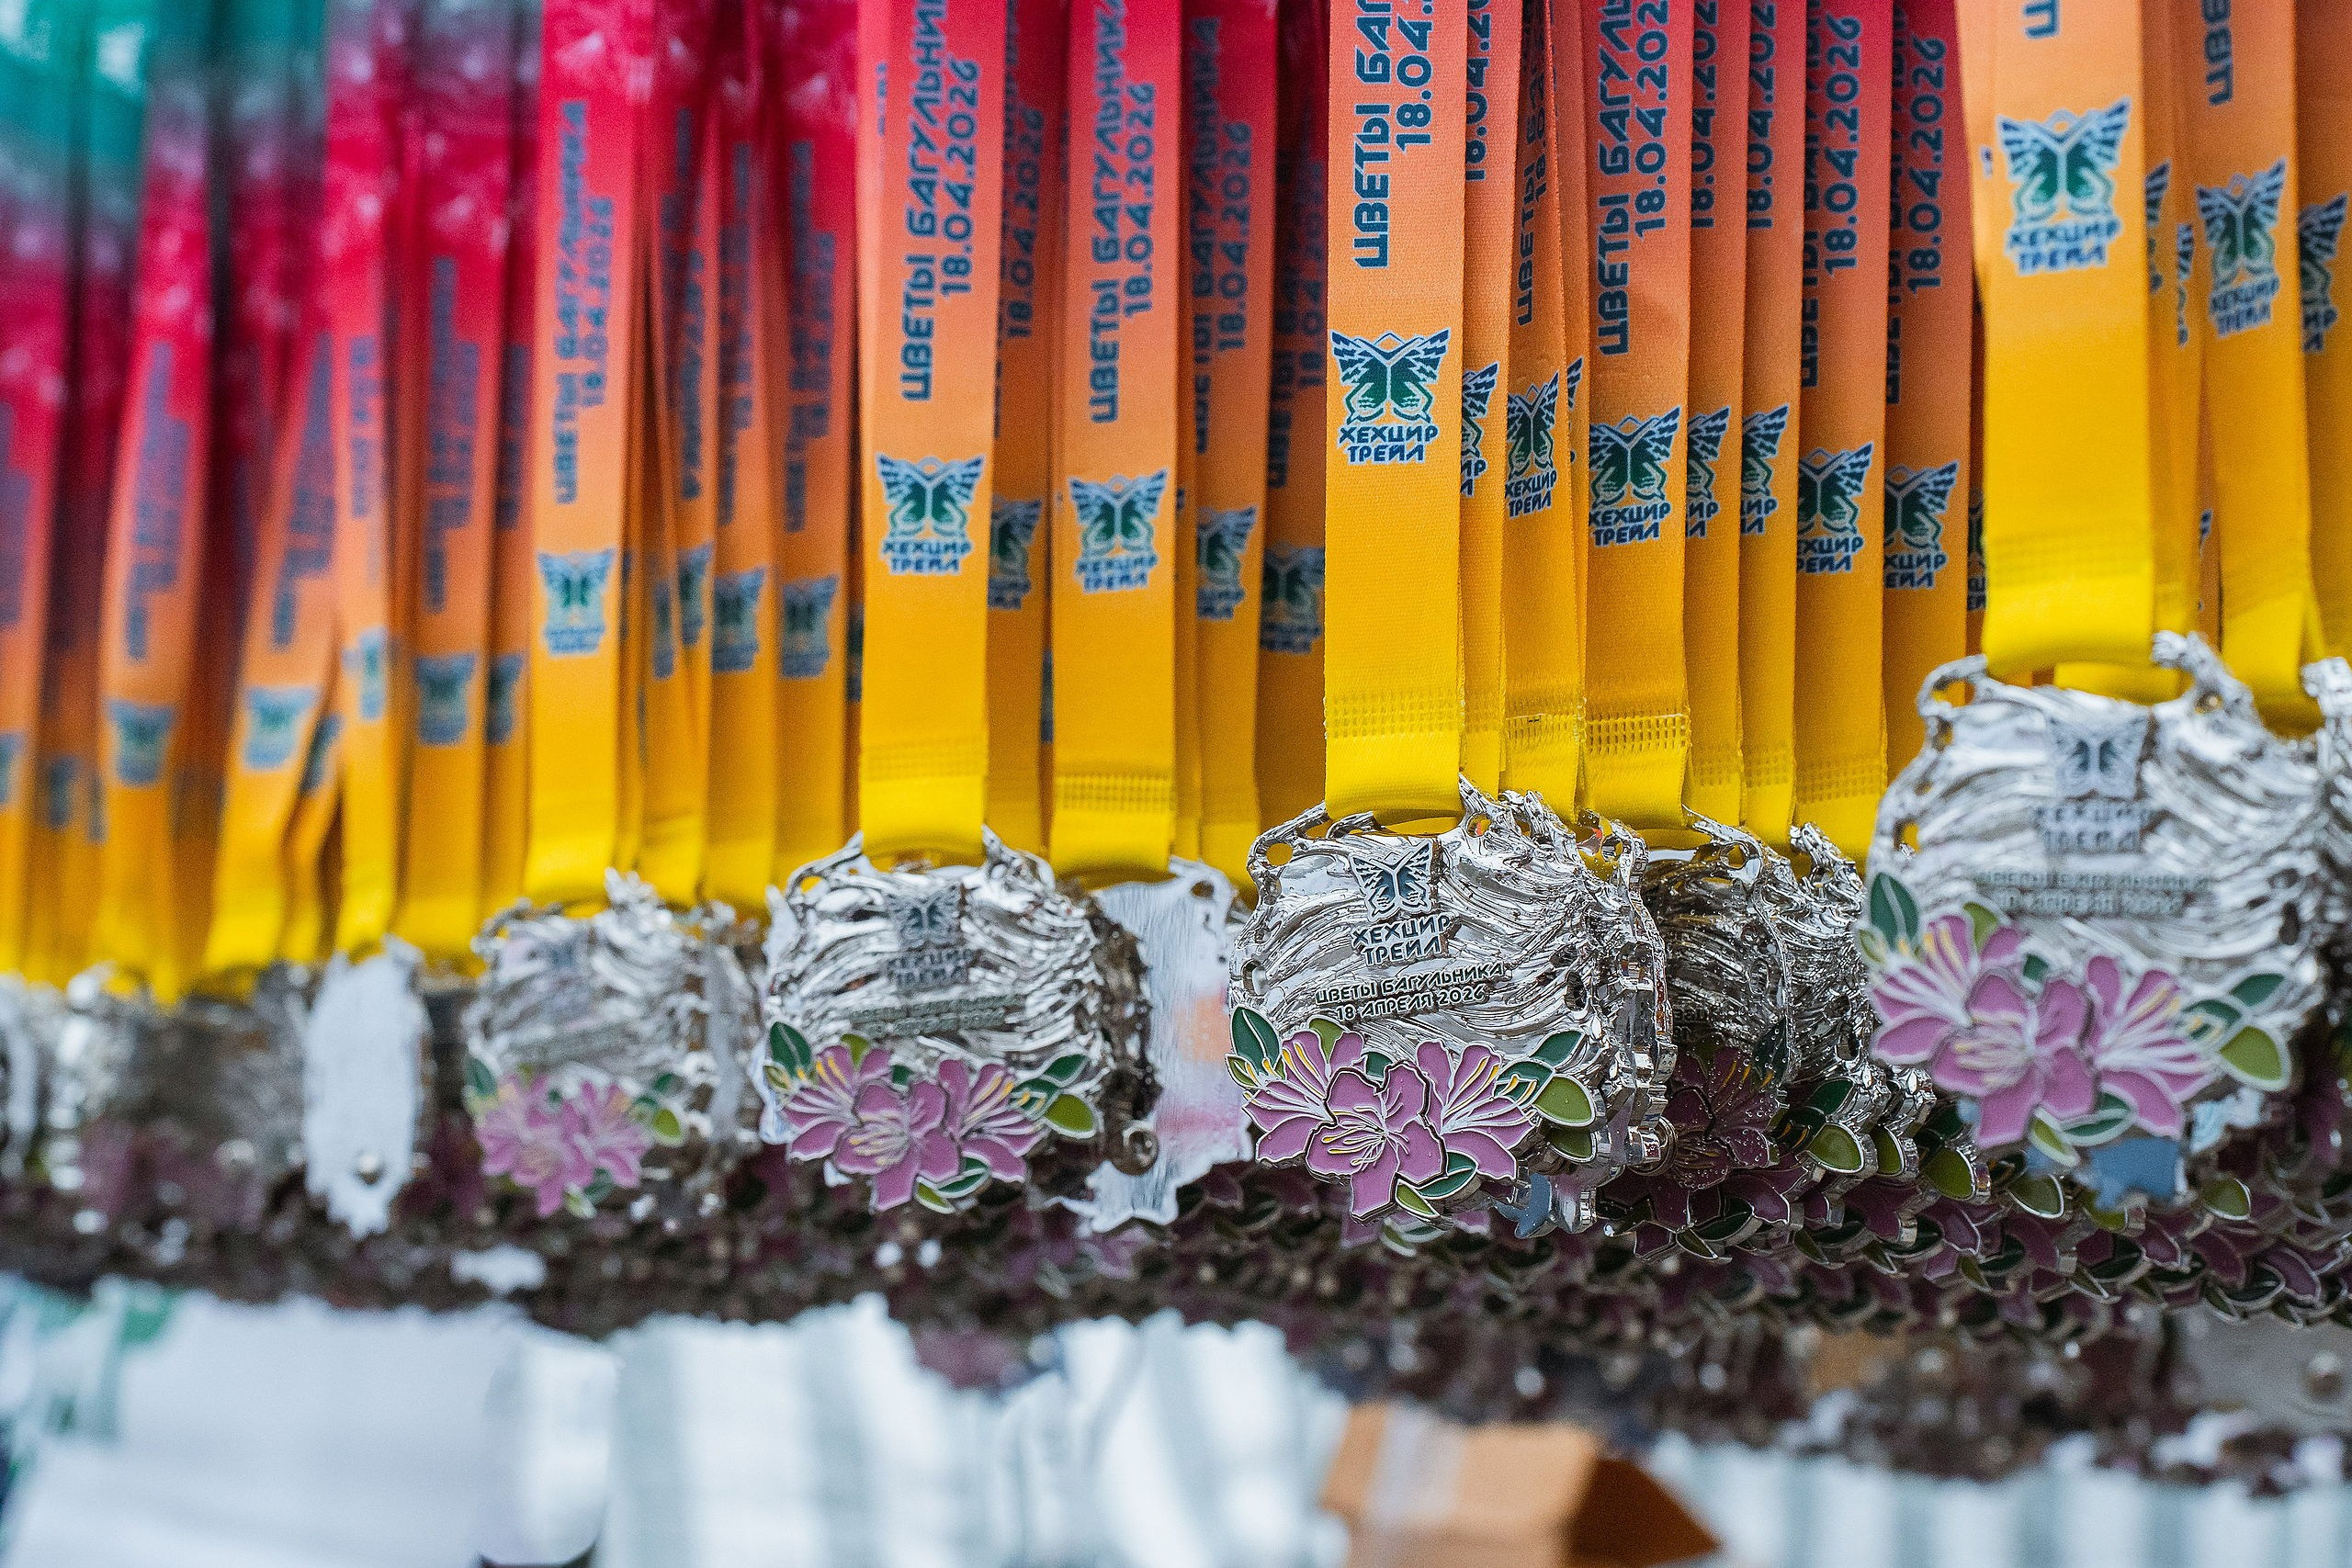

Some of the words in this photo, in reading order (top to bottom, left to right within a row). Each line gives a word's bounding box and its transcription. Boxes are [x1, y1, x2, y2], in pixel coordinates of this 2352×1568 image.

[906, 0, 945, 237] БАГУЛЬНИ
[940, 54, 979, 298] 18.04.2026
[1124, 82, 1156, 318] 18.04.2026
[1353, 103, 1390, 269] ЦВЕТЫ
[1824, 12, 1861, 277] 18.04.2026
[1907, 33, 1946, 297] 18.04.2026
[1217, 121, 1251, 351] 18.04.2026
[1516, 162, 1535, 326] ЦВЕТЫ
[1597, 193, 1631, 356] ЦВЕТЫ
[900, 254, 936, 401] ЦВЕТЫ
[1089, 279, 1120, 423] ЦВЕТЫ
[1339, 425, 1438, 444] ХЕХЦИР
[1505, 469, 1557, 499] ХЕХЦИР
[1589, 502, 1671, 526] ХЕХЦИР
[1315, 982, 1376, 1005] ЦВЕТЫ
[1381, 963, 1505, 995] БАГУЛЬНИКА
[1336, 1004, 1355, 1021] 18
[1361, 994, 1433, 1017] АПРЕЛЯ
[1439, 985, 1487, 1006] 2026
[1352, 916, 1451, 947] ХЕХЦИР
